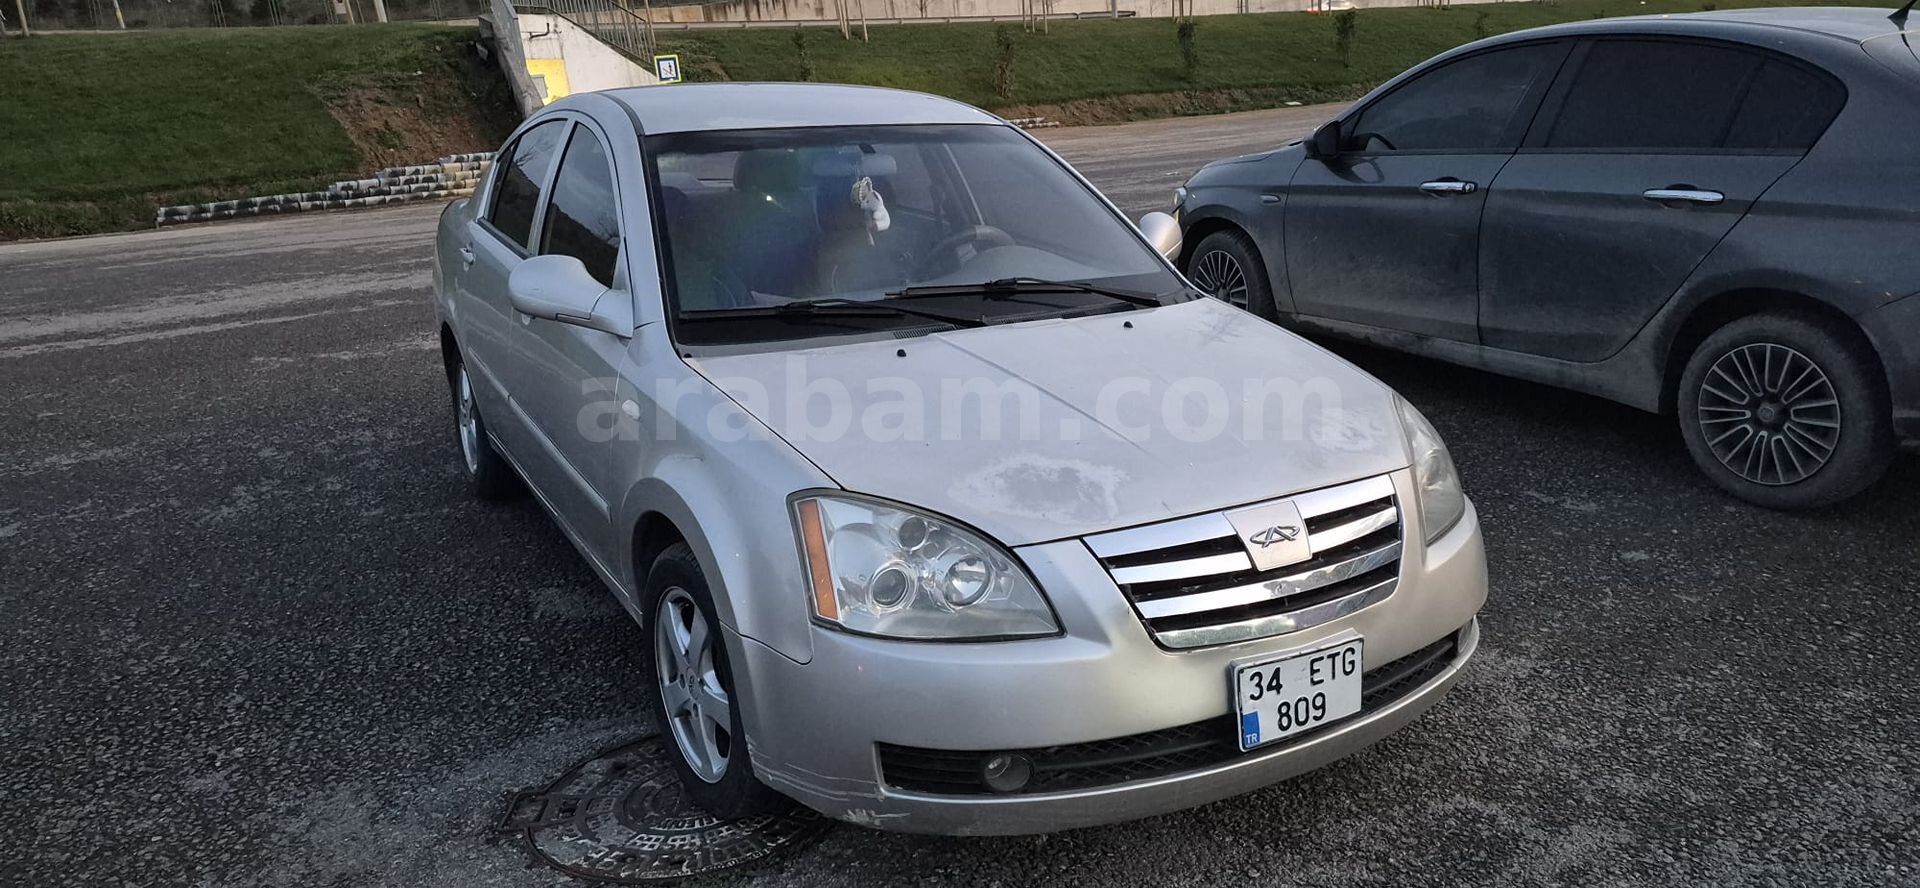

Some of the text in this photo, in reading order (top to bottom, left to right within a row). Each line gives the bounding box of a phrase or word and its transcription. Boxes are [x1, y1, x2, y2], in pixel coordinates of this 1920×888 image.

[1249, 647, 1356, 701] 34 ETG
[1277, 692, 1326, 731] 809
[1246, 733, 1258, 744] TR
